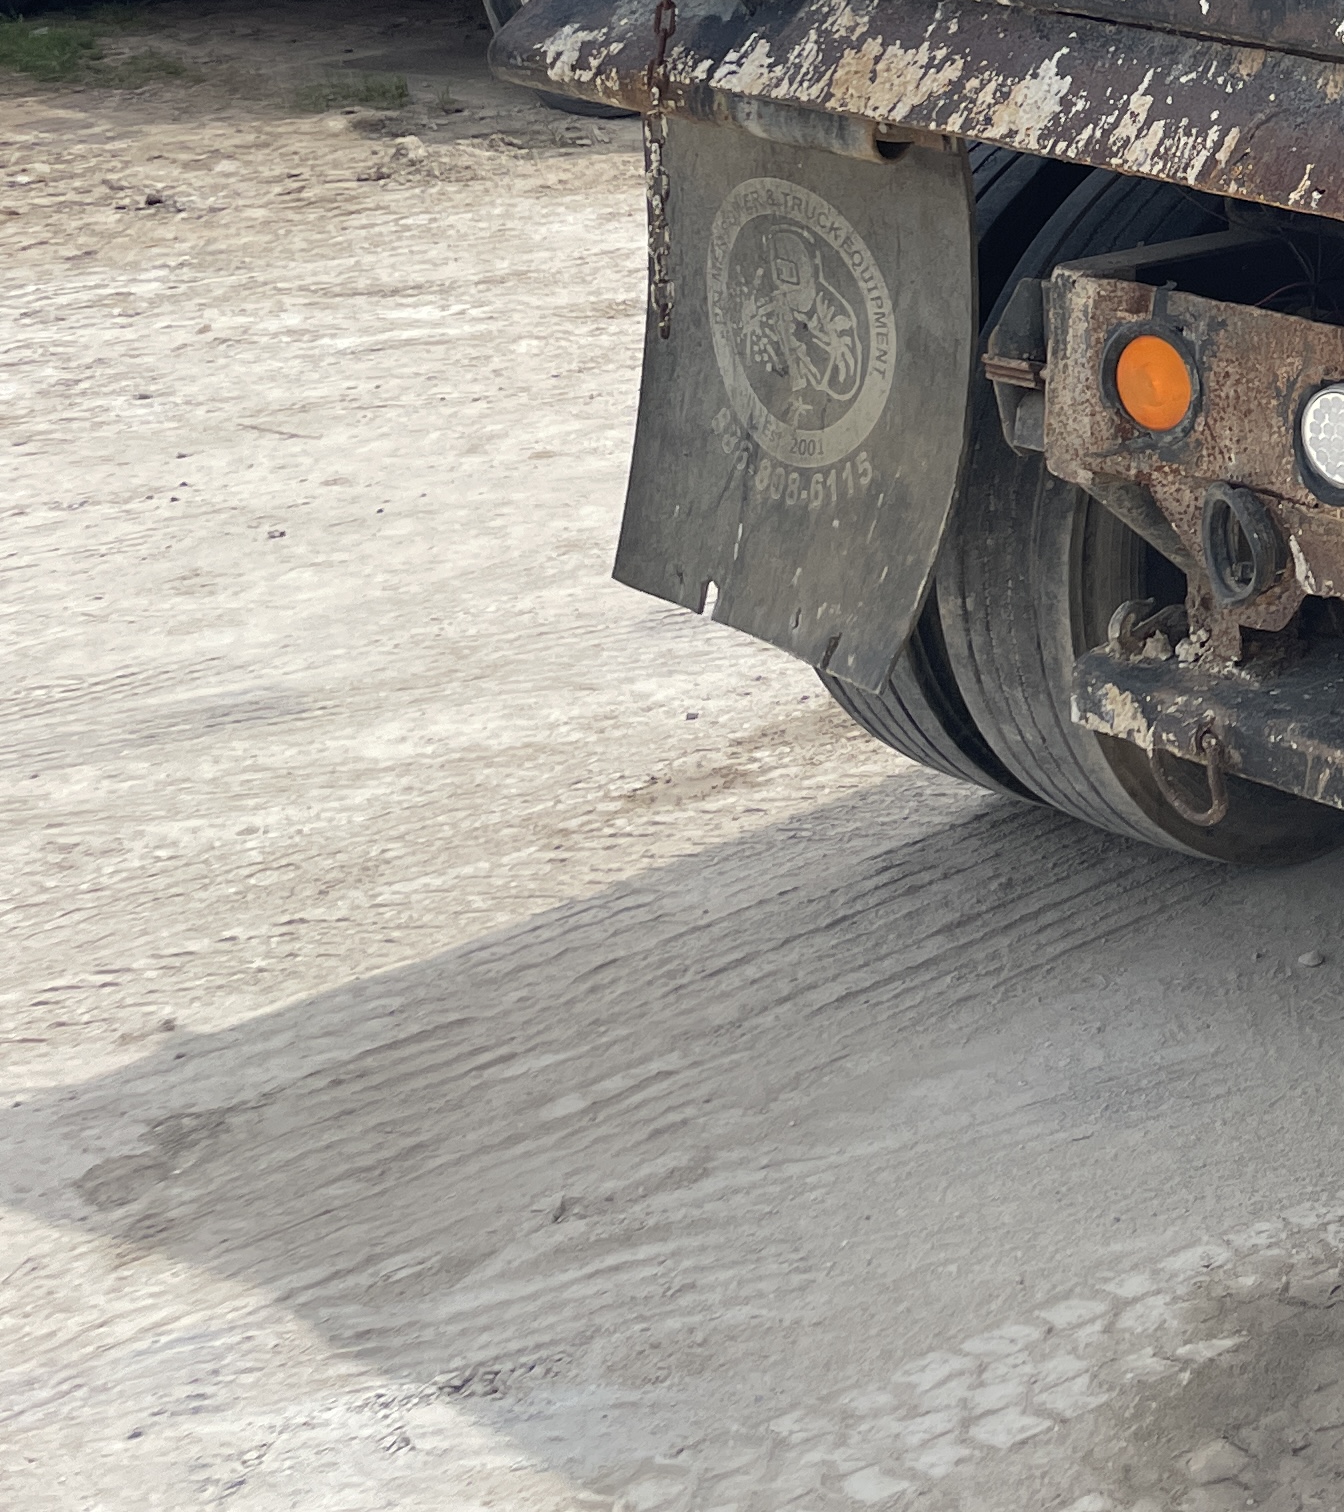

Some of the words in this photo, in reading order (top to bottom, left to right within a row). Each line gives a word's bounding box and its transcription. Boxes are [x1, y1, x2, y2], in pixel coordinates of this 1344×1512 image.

[780, 191, 844, 241] TRUCK
[840, 238, 889, 381] EQUIPMENT
[789, 437, 825, 457] 2001
